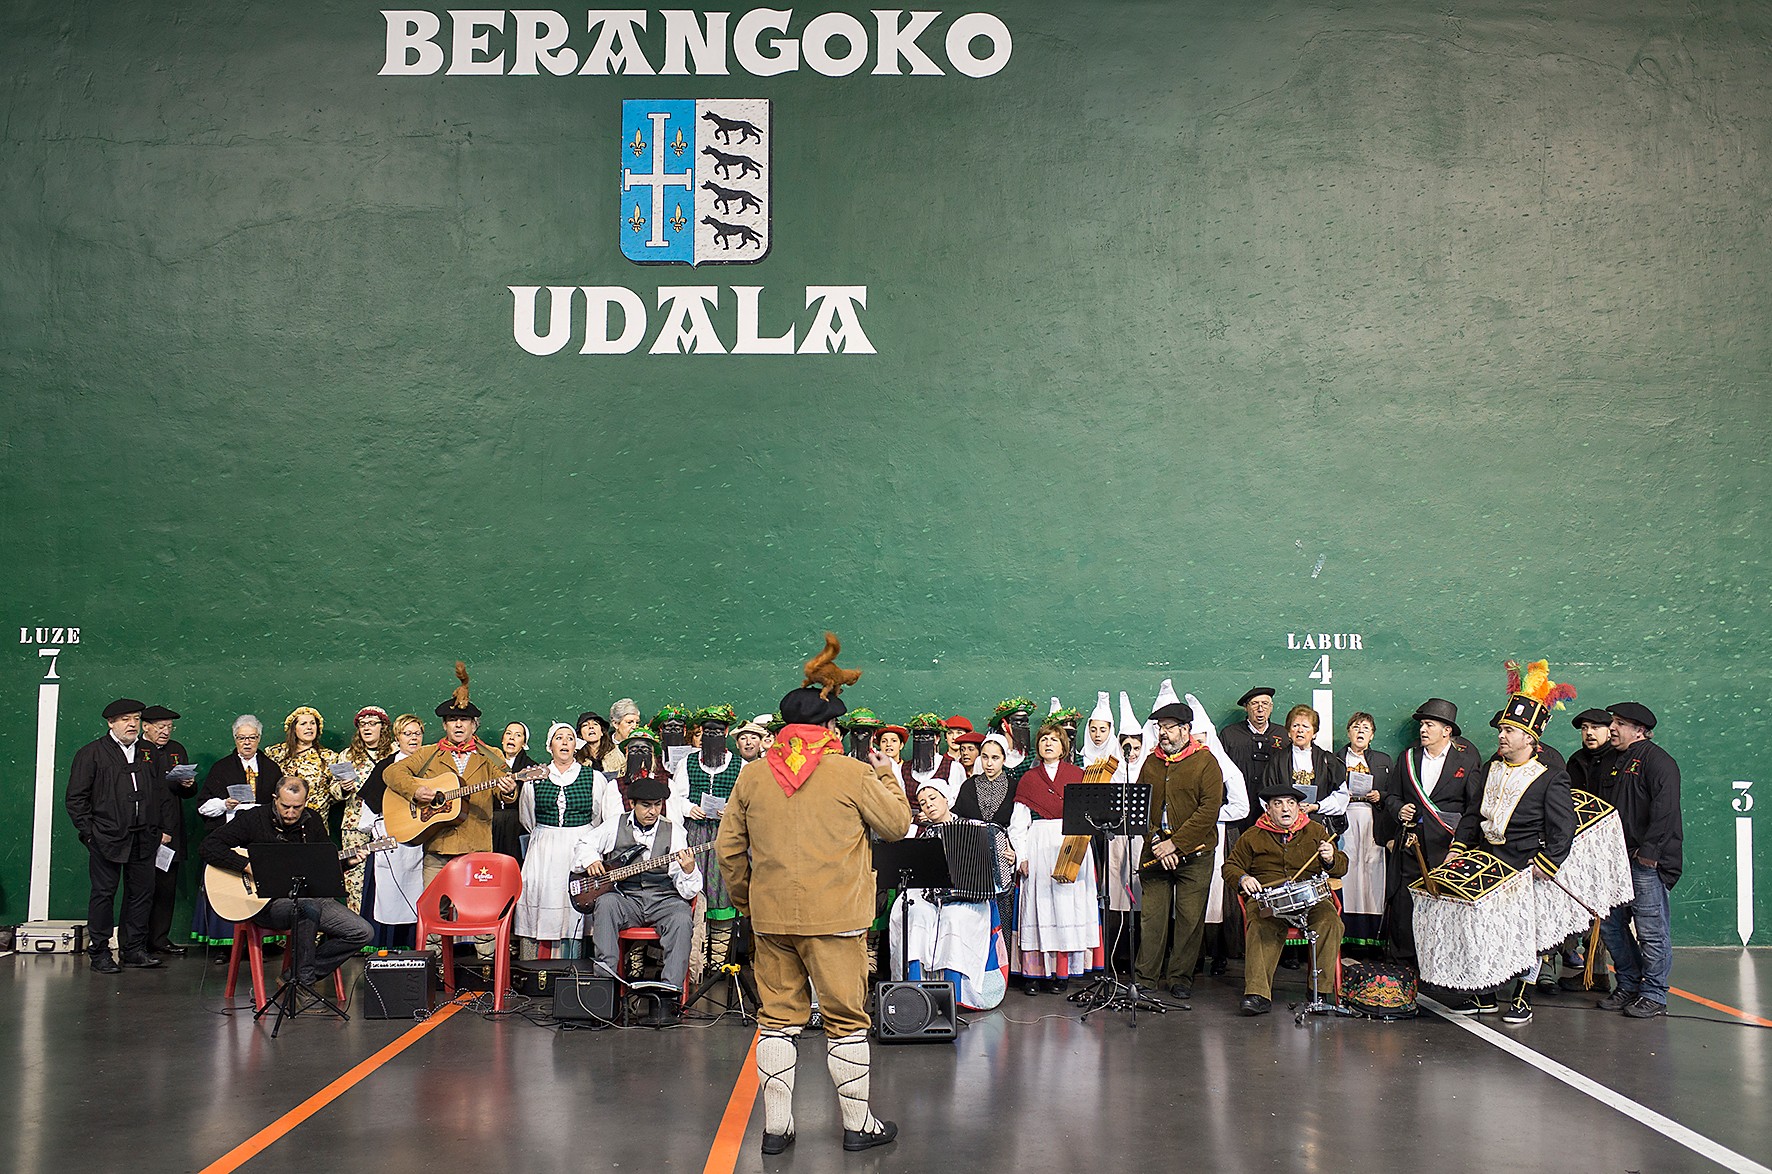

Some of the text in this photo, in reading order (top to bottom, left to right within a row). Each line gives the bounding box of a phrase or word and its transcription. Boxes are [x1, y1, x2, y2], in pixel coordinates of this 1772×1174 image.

[378, 9, 1014, 78] BERANGOKO
[507, 285, 878, 356] UDALA
[19, 627, 81, 644] LUZE
[1287, 633, 1364, 650] LABUR
[38, 648, 61, 679] 7
[1308, 654, 1334, 685] 4
[1731, 781, 1754, 812] 3
